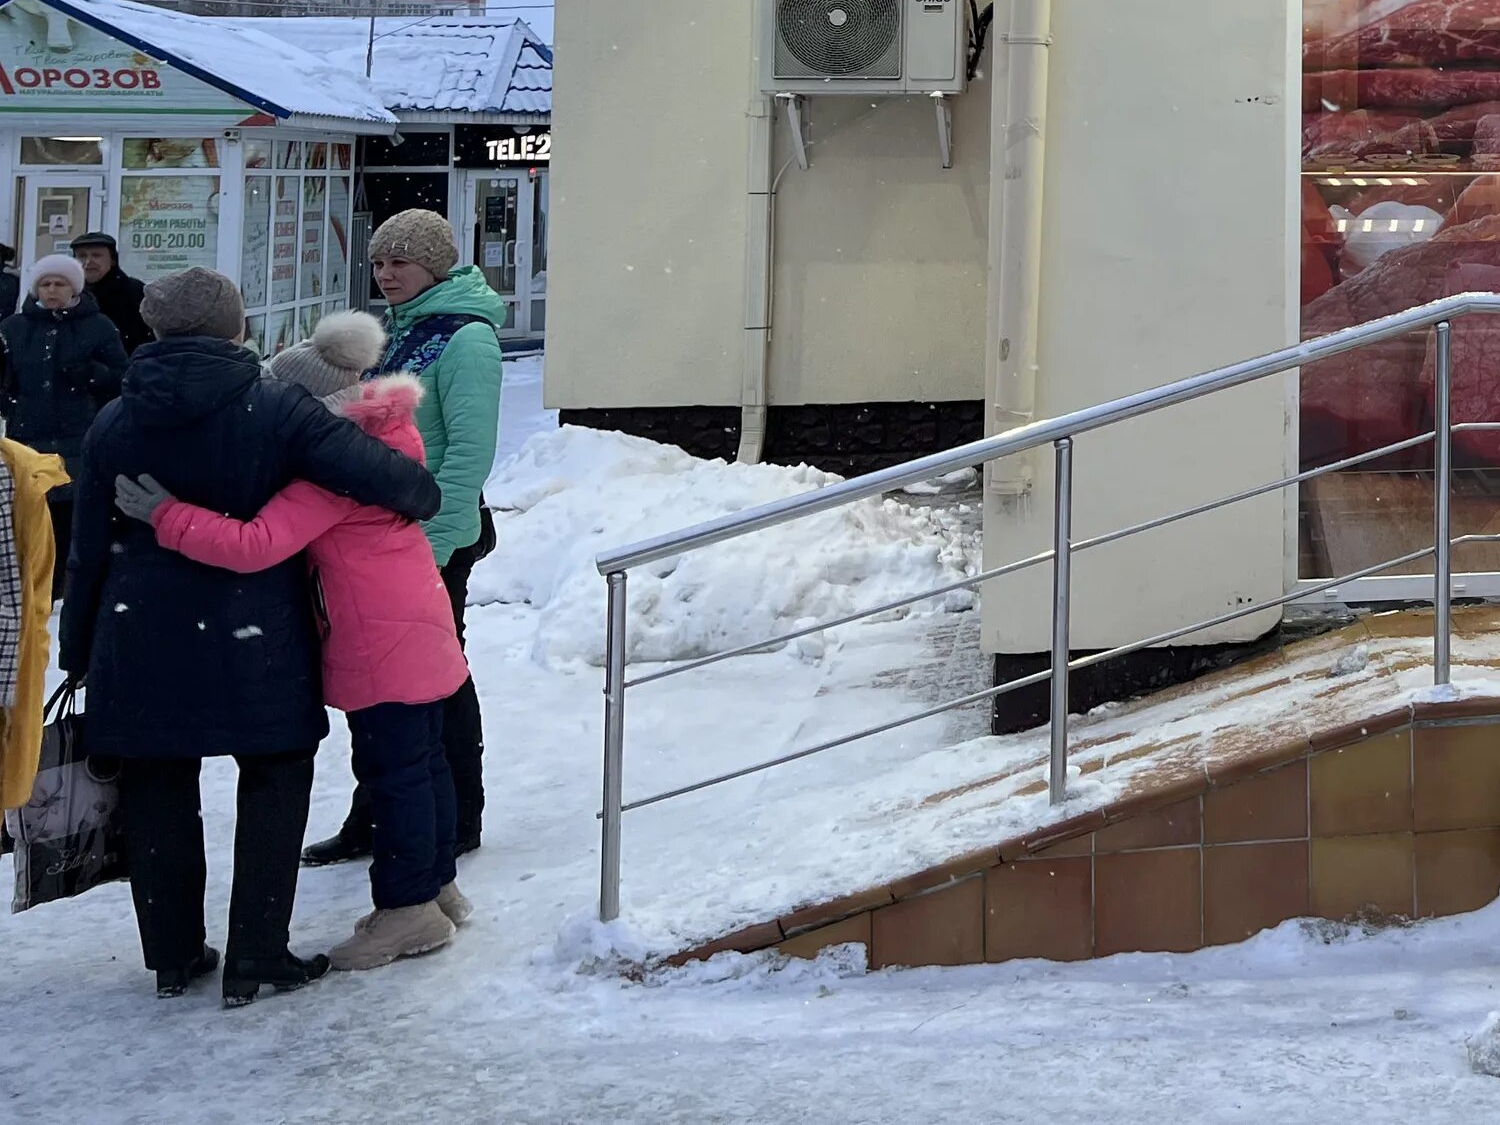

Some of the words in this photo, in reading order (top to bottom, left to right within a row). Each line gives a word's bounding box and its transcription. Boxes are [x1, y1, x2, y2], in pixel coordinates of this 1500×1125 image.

[486, 133, 551, 162] TELE2
[133, 218, 167, 229] РЕЖИМ
[169, 218, 206, 229] РАБОТЫ
[132, 233, 205, 249] 9.00-20.00
